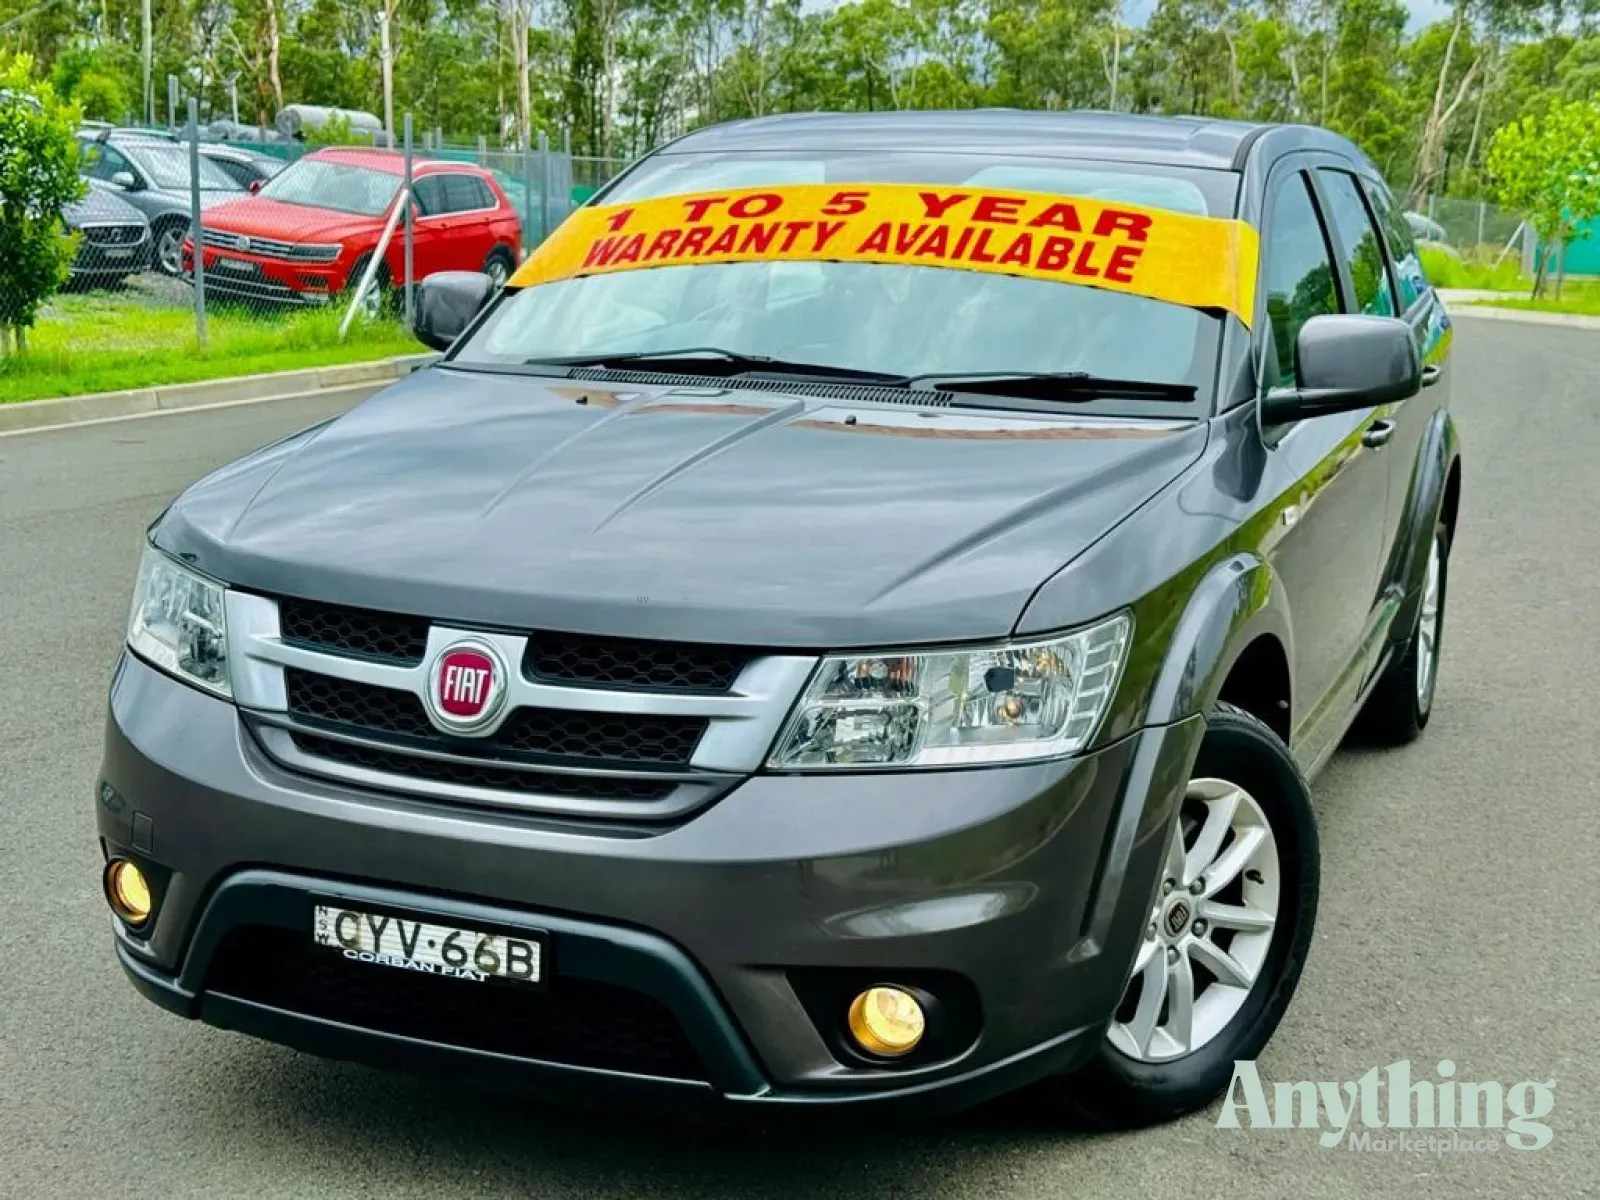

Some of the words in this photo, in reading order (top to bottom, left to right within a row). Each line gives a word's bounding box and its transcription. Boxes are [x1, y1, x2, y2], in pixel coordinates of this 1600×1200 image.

[607, 208, 635, 232] 1
[684, 193, 784, 223] TO
[820, 191, 870, 216] 5
[918, 192, 1153, 243] YEAR
[581, 221, 847, 269] WARRANTY
[856, 222, 1144, 284] AVAILABLE
[443, 664, 489, 704] FIAT
[441, 966, 490, 982] FIAT
